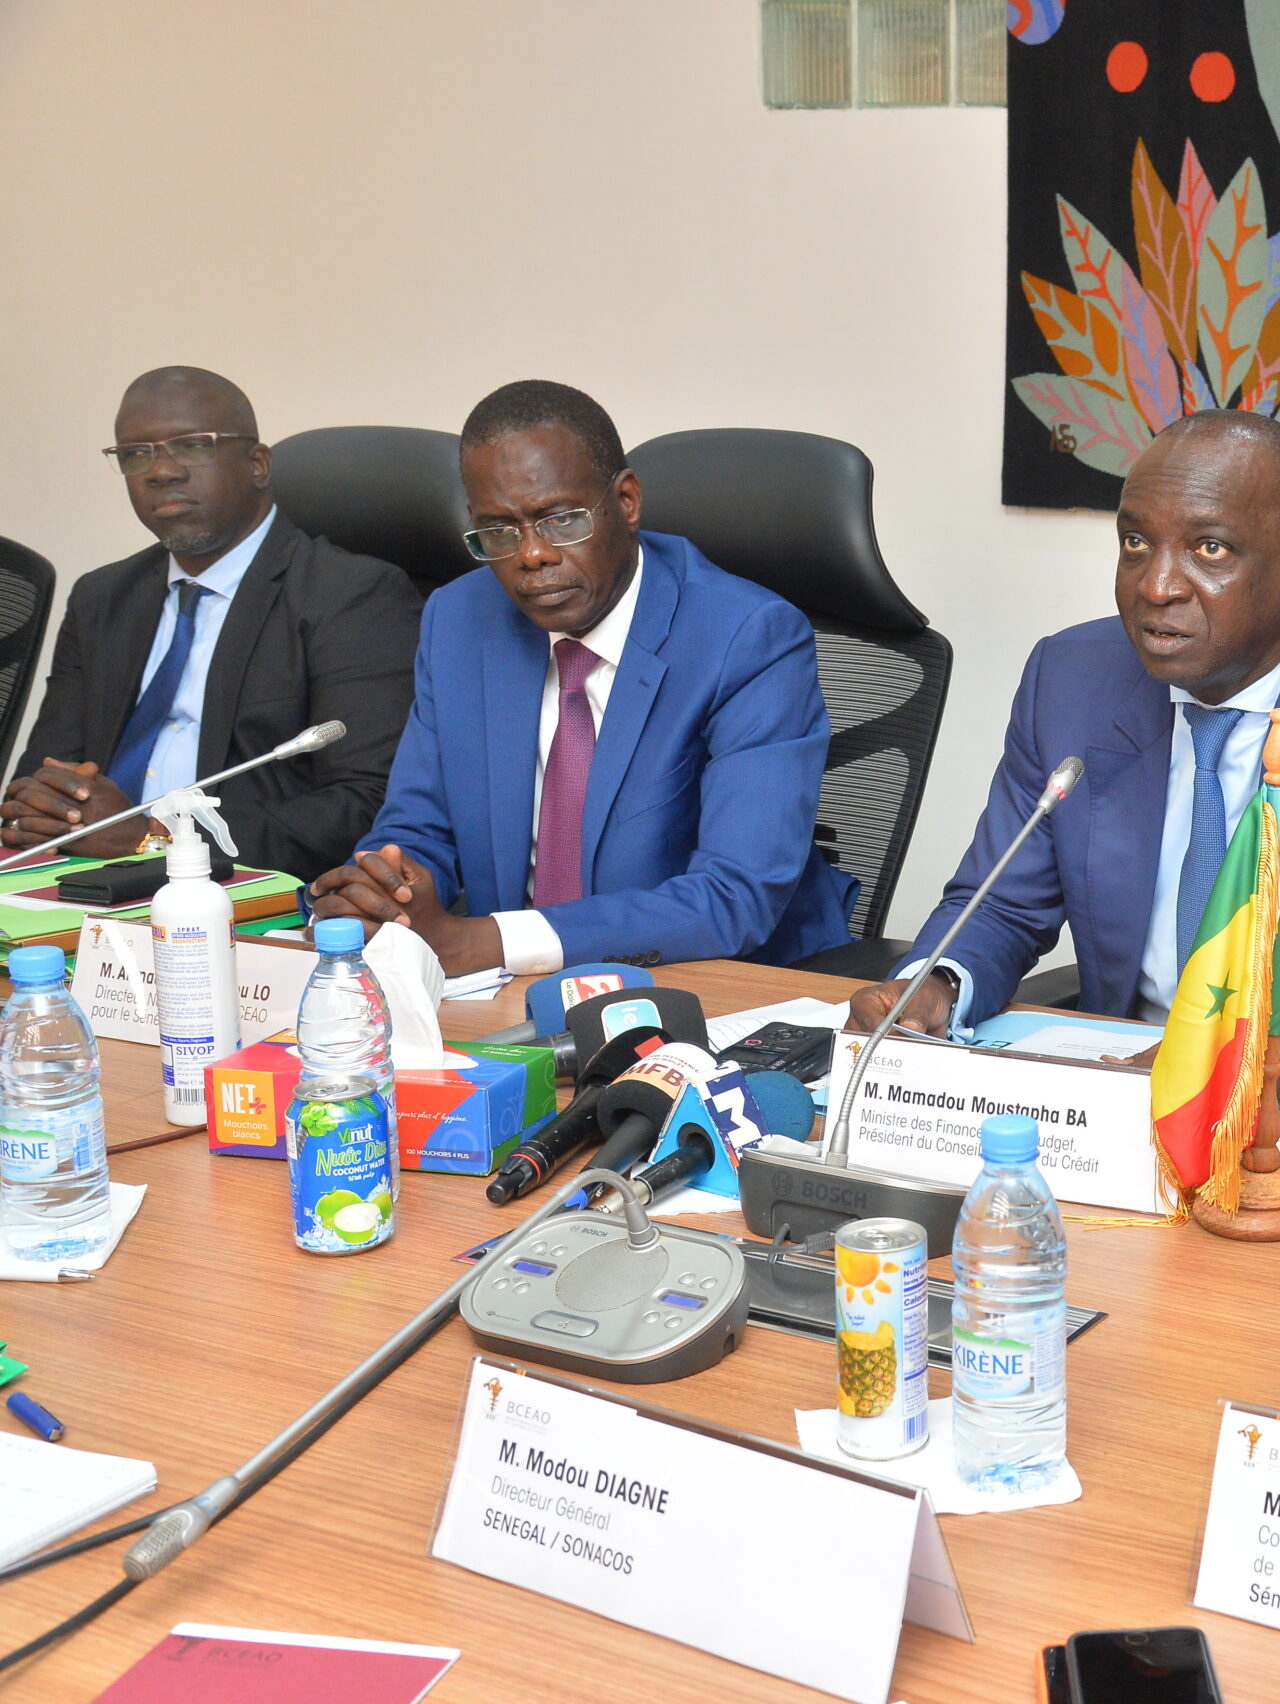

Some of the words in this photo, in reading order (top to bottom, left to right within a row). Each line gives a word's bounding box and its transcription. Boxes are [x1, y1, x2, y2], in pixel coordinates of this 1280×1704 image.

[100, 962, 115, 979] M.
[253, 984, 270, 1001] LO
[91, 1004, 117, 1021] pour
[120, 1007, 130, 1020] le
[176, 1045, 215, 1056] SIVOP
[864, 1081, 882, 1100] M.
[887, 1085, 965, 1111] Mamadou
[1066, 1108, 1088, 1128] BA
[223, 1119, 268, 1131] Mouchoirs
[861, 1108, 908, 1128] Ministre
[911, 1115, 932, 1132] des
[232, 1129, 261, 1140] blancs
[338, 1122, 374, 1144] Vinut
[858, 1126, 914, 1147] Président
[916, 1132, 932, 1150] du
[416, 1150, 451, 1158] MOUCHOIRS
[1041, 1151, 1058, 1168] du
[1061, 1154, 1099, 1174] Crédit
[332, 1165, 369, 1177] COCONUT
[369, 1158, 385, 1170] WATER
[802, 1180, 867, 1209] BOSCH
[581, 1227, 608, 1237] BOSCH
[953, 1341, 1023, 1375] KIRÈNE
[506, 1401, 551, 1425] BCEAO
[499, 1439, 519, 1467] M.
[526, 1447, 589, 1488] Modou
[595, 1469, 669, 1514] DIAGNE
[491, 1475, 552, 1511] Directeur
[555, 1496, 610, 1531] Général
[484, 1508, 546, 1546] SENEGAL
[550, 1531, 560, 1549] /
[562, 1533, 634, 1575] SONACOS
[1253, 1555, 1274, 1577] de
